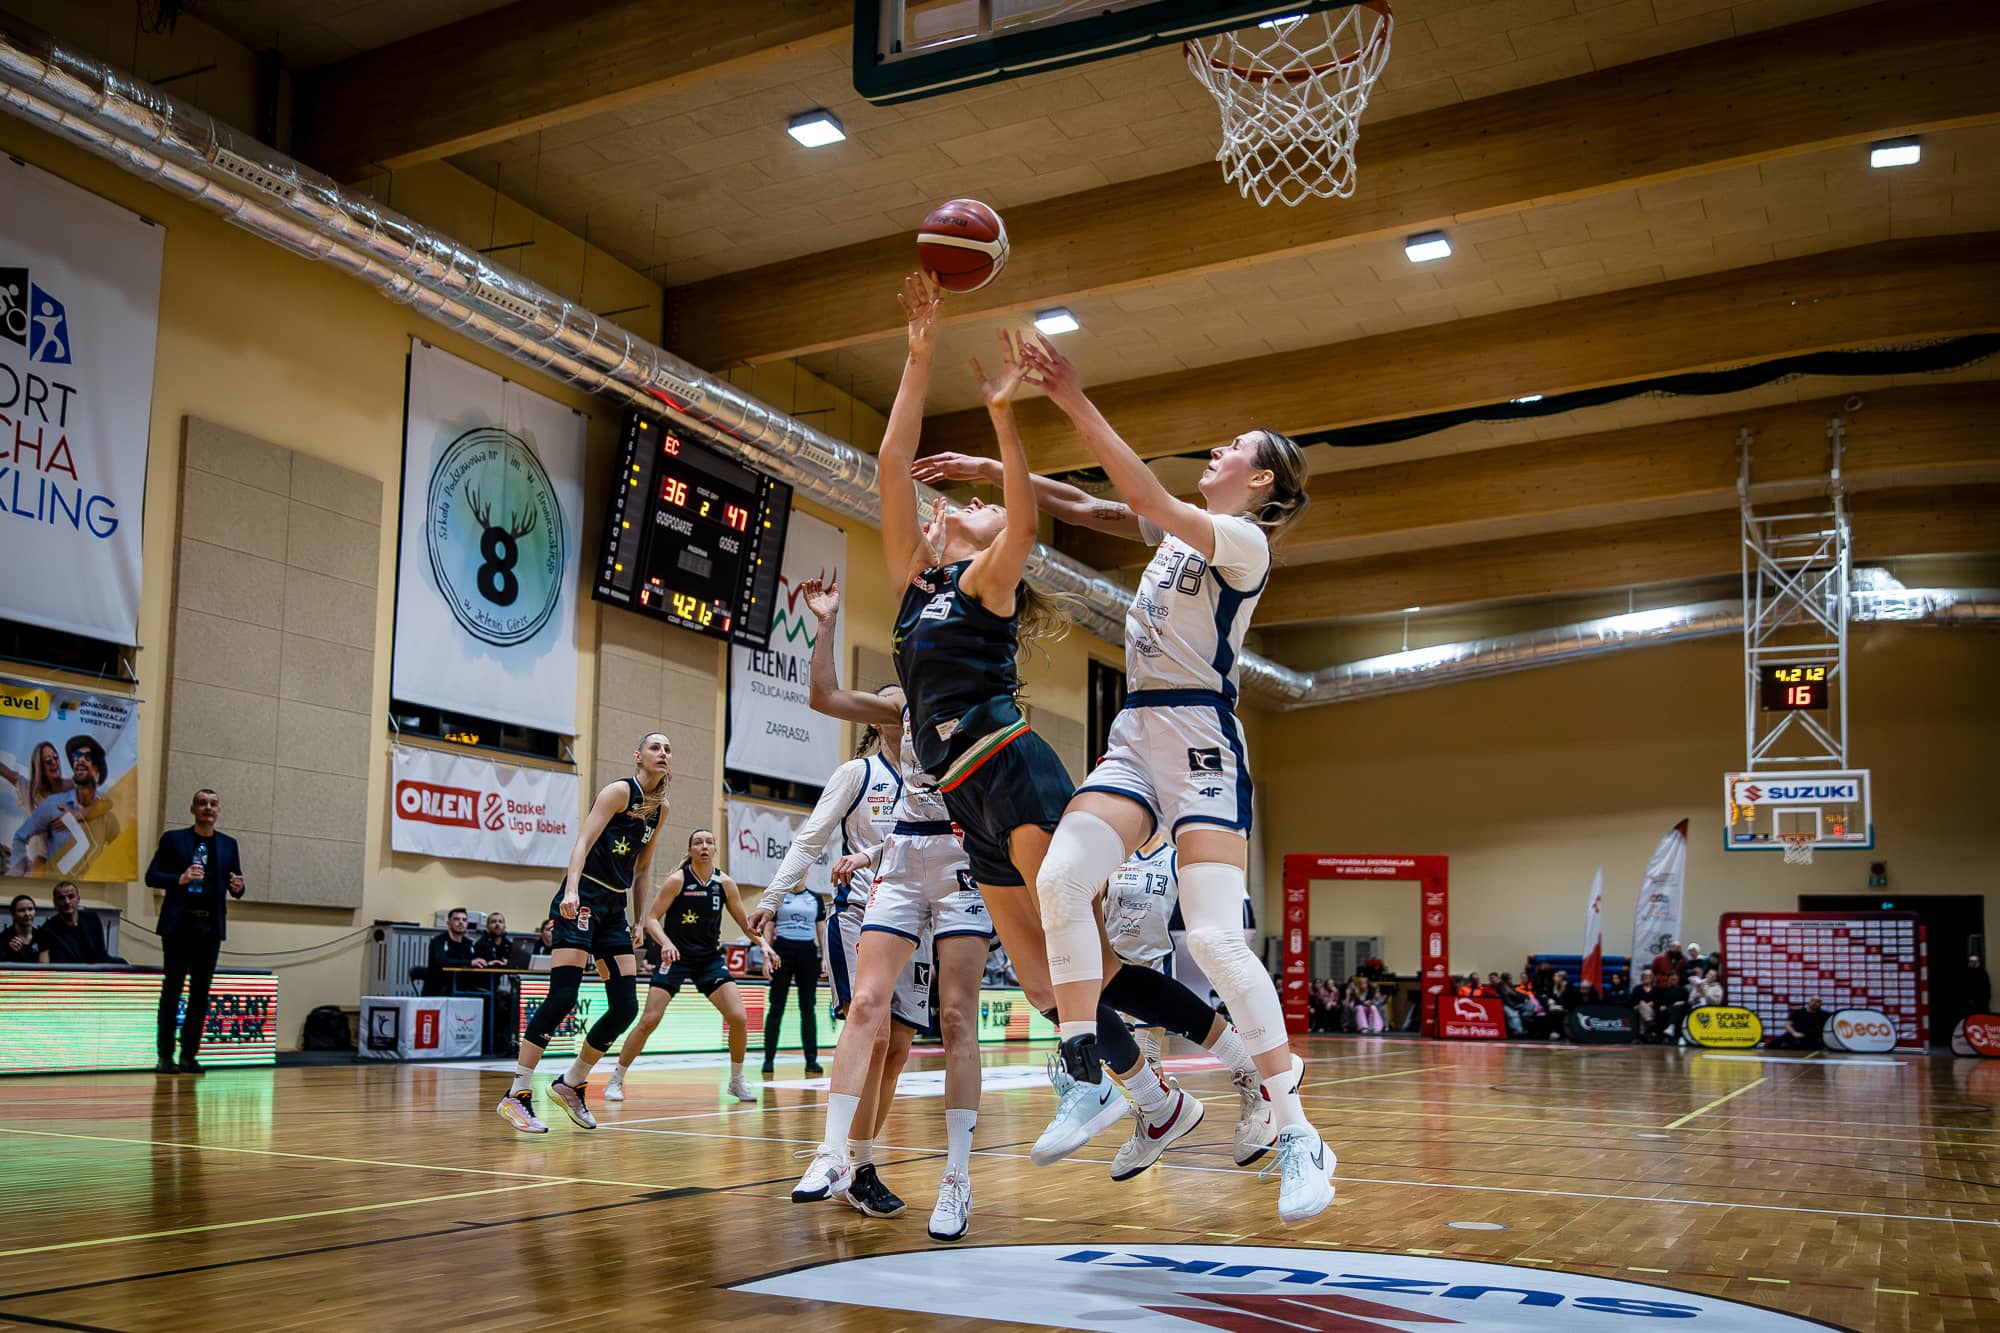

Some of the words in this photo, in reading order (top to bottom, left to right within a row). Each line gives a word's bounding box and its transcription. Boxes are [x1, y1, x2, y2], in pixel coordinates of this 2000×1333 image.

[664, 477, 688, 508] 36
[700, 501, 711, 517] 2
[728, 504, 748, 532] 47
[477, 526, 518, 606] 8
[1159, 552, 1207, 596] 38
[1788, 685, 1811, 705] 16
[765, 721, 811, 742] ZAPRASZA
[1768, 785, 1853, 799] SUZUKI
[401, 787, 473, 820] ORLEN
[507, 800, 546, 816] Basket
[509, 821, 533, 835] Liga
[537, 821, 566, 835] Kobiet
[1145, 872, 1168, 896] 13
[712, 896, 720, 911] 9
[729, 950, 743, 969] 5
[1056, 1249, 1703, 1319] SUZUKI
